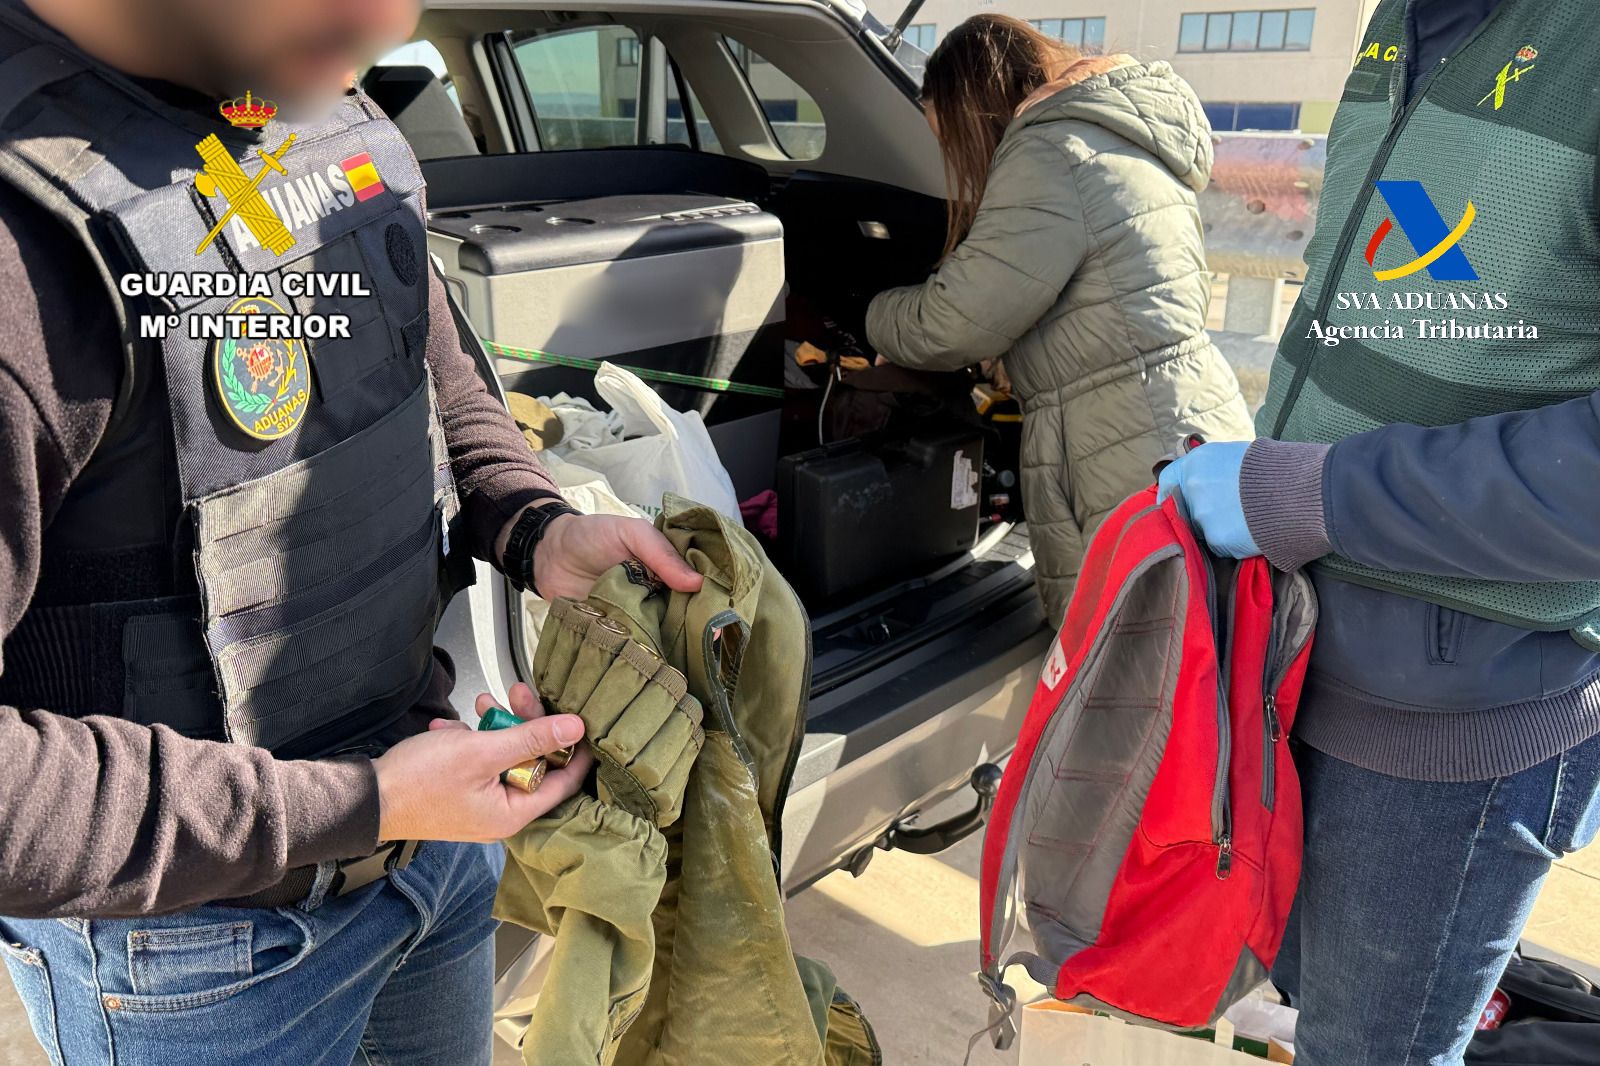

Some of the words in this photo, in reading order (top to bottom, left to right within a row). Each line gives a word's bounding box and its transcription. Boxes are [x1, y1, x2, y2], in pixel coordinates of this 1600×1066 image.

[226, 163, 355, 253] AUANAS
[254, 388, 307, 433] ADUANAS
[276, 415, 295, 433] SVA
